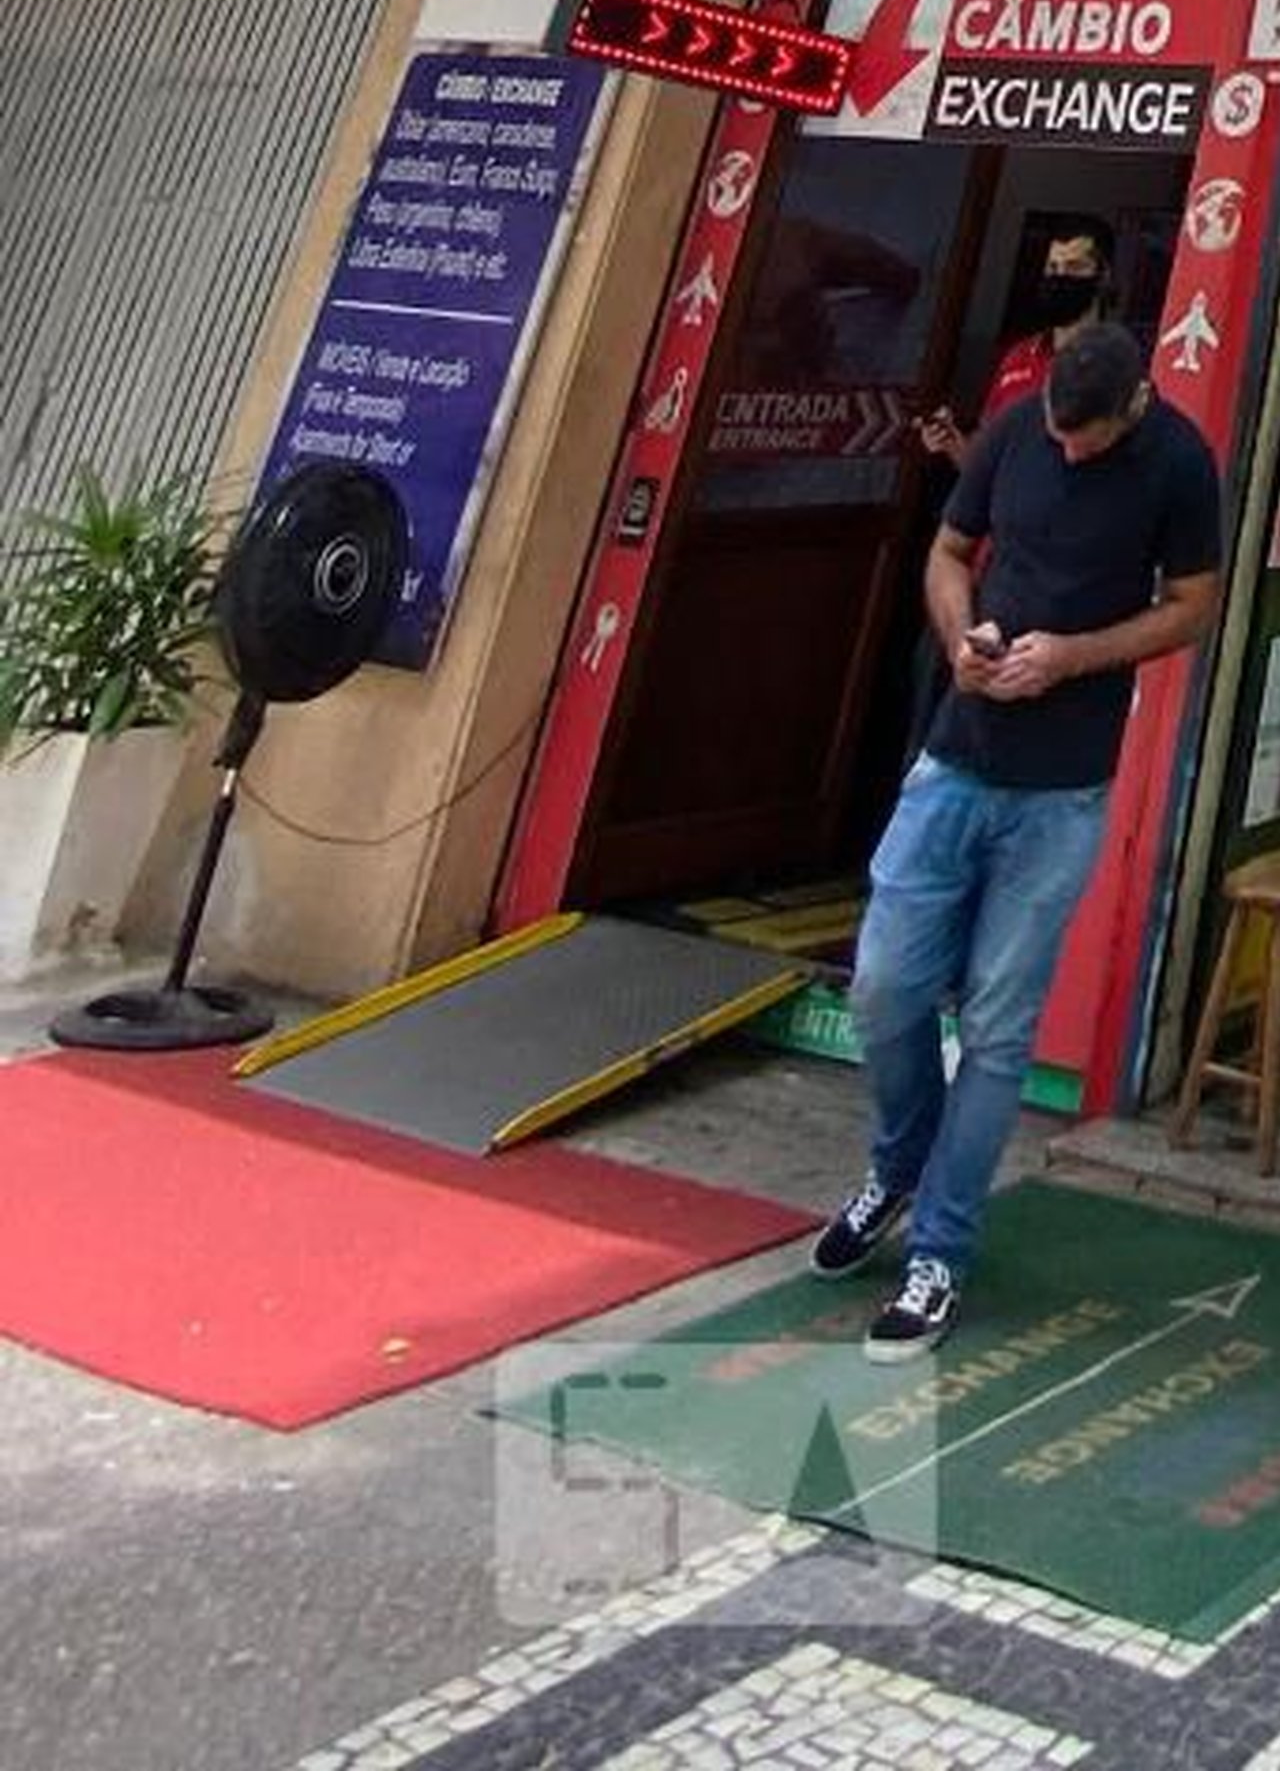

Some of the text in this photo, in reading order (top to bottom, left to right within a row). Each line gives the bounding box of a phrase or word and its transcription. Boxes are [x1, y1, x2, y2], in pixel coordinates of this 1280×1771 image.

[936, 78, 1194, 135] EXCHANGE
[718, 392, 849, 425] ENTRADA
[844, 1298, 1121, 1440] EXCHANGE
[1001, 1338, 1268, 1486] EXCHANGE
